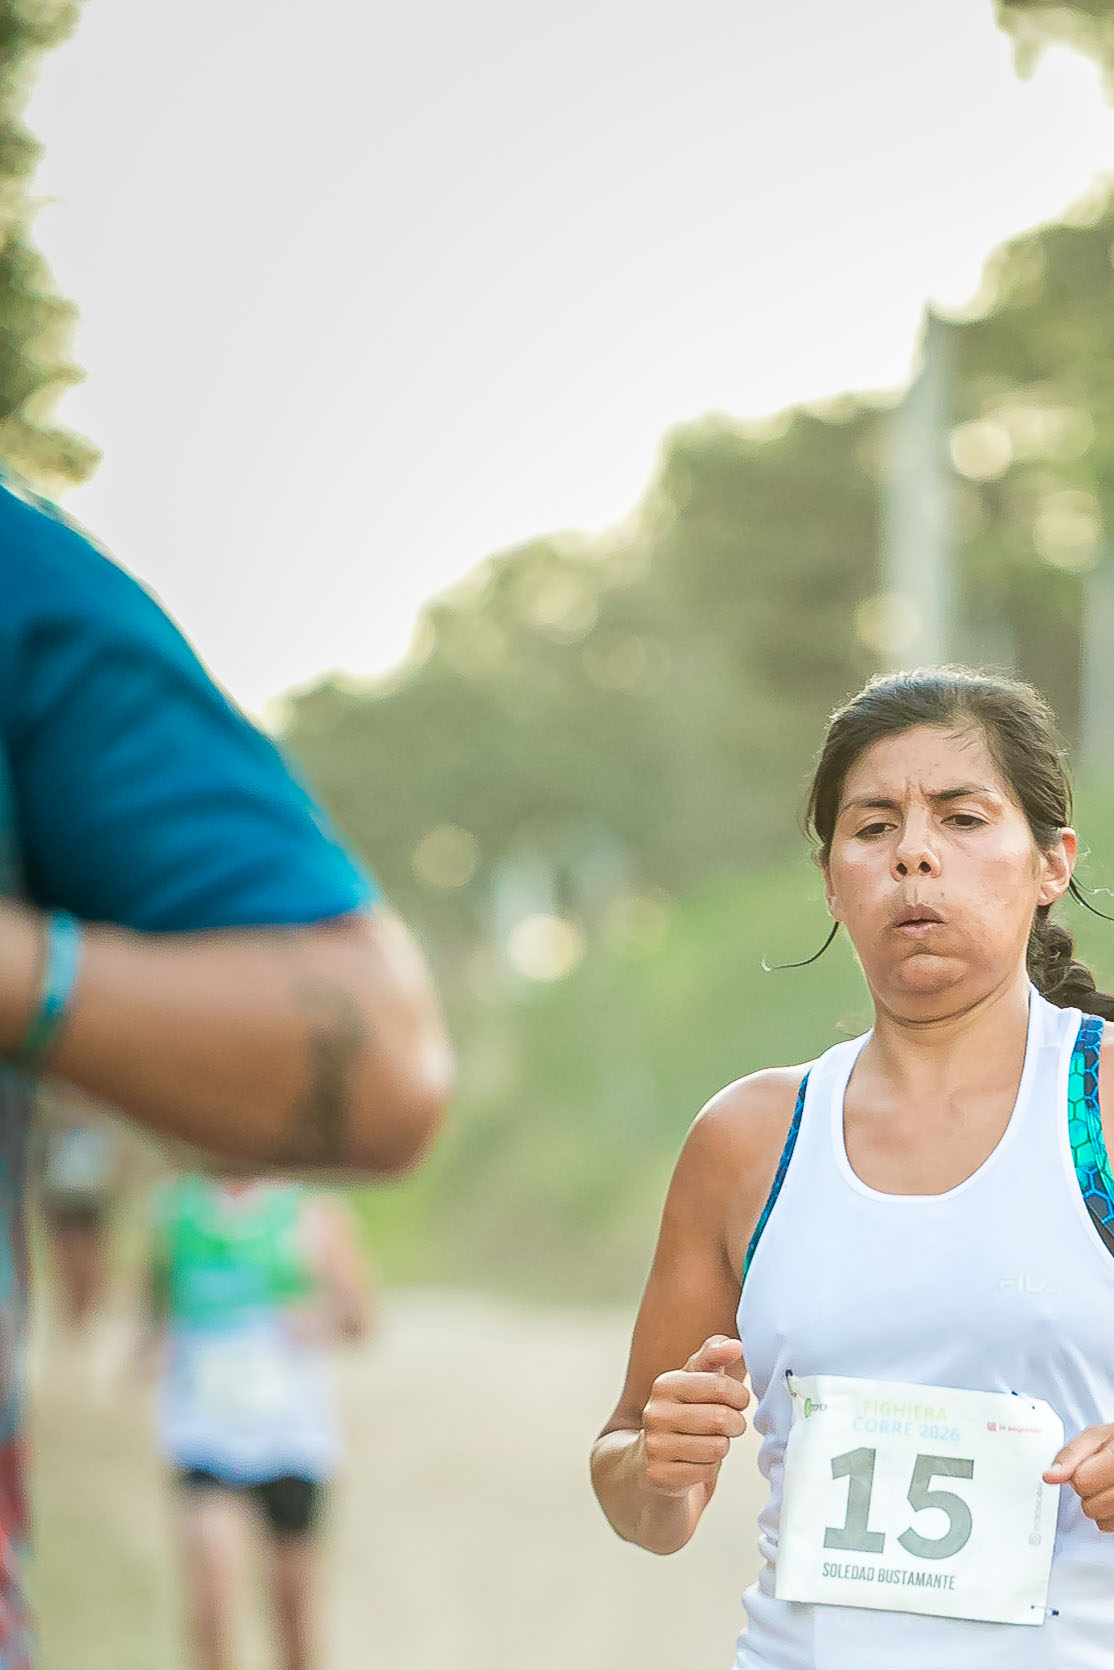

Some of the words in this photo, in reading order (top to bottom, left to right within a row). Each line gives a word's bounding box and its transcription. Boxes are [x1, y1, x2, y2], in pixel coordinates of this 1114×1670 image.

[999, 1272, 1057, 1294] FILA
[863, 1399, 948, 1422] FIGHIERA
[852, 1416, 913, 1437] CORRE
[919, 1423, 961, 1442] 2026
[823, 1446, 975, 1560] 15
[822, 1562, 875, 1583] SOLEDAD
[877, 1568, 956, 1591] BUSTAMANTE
